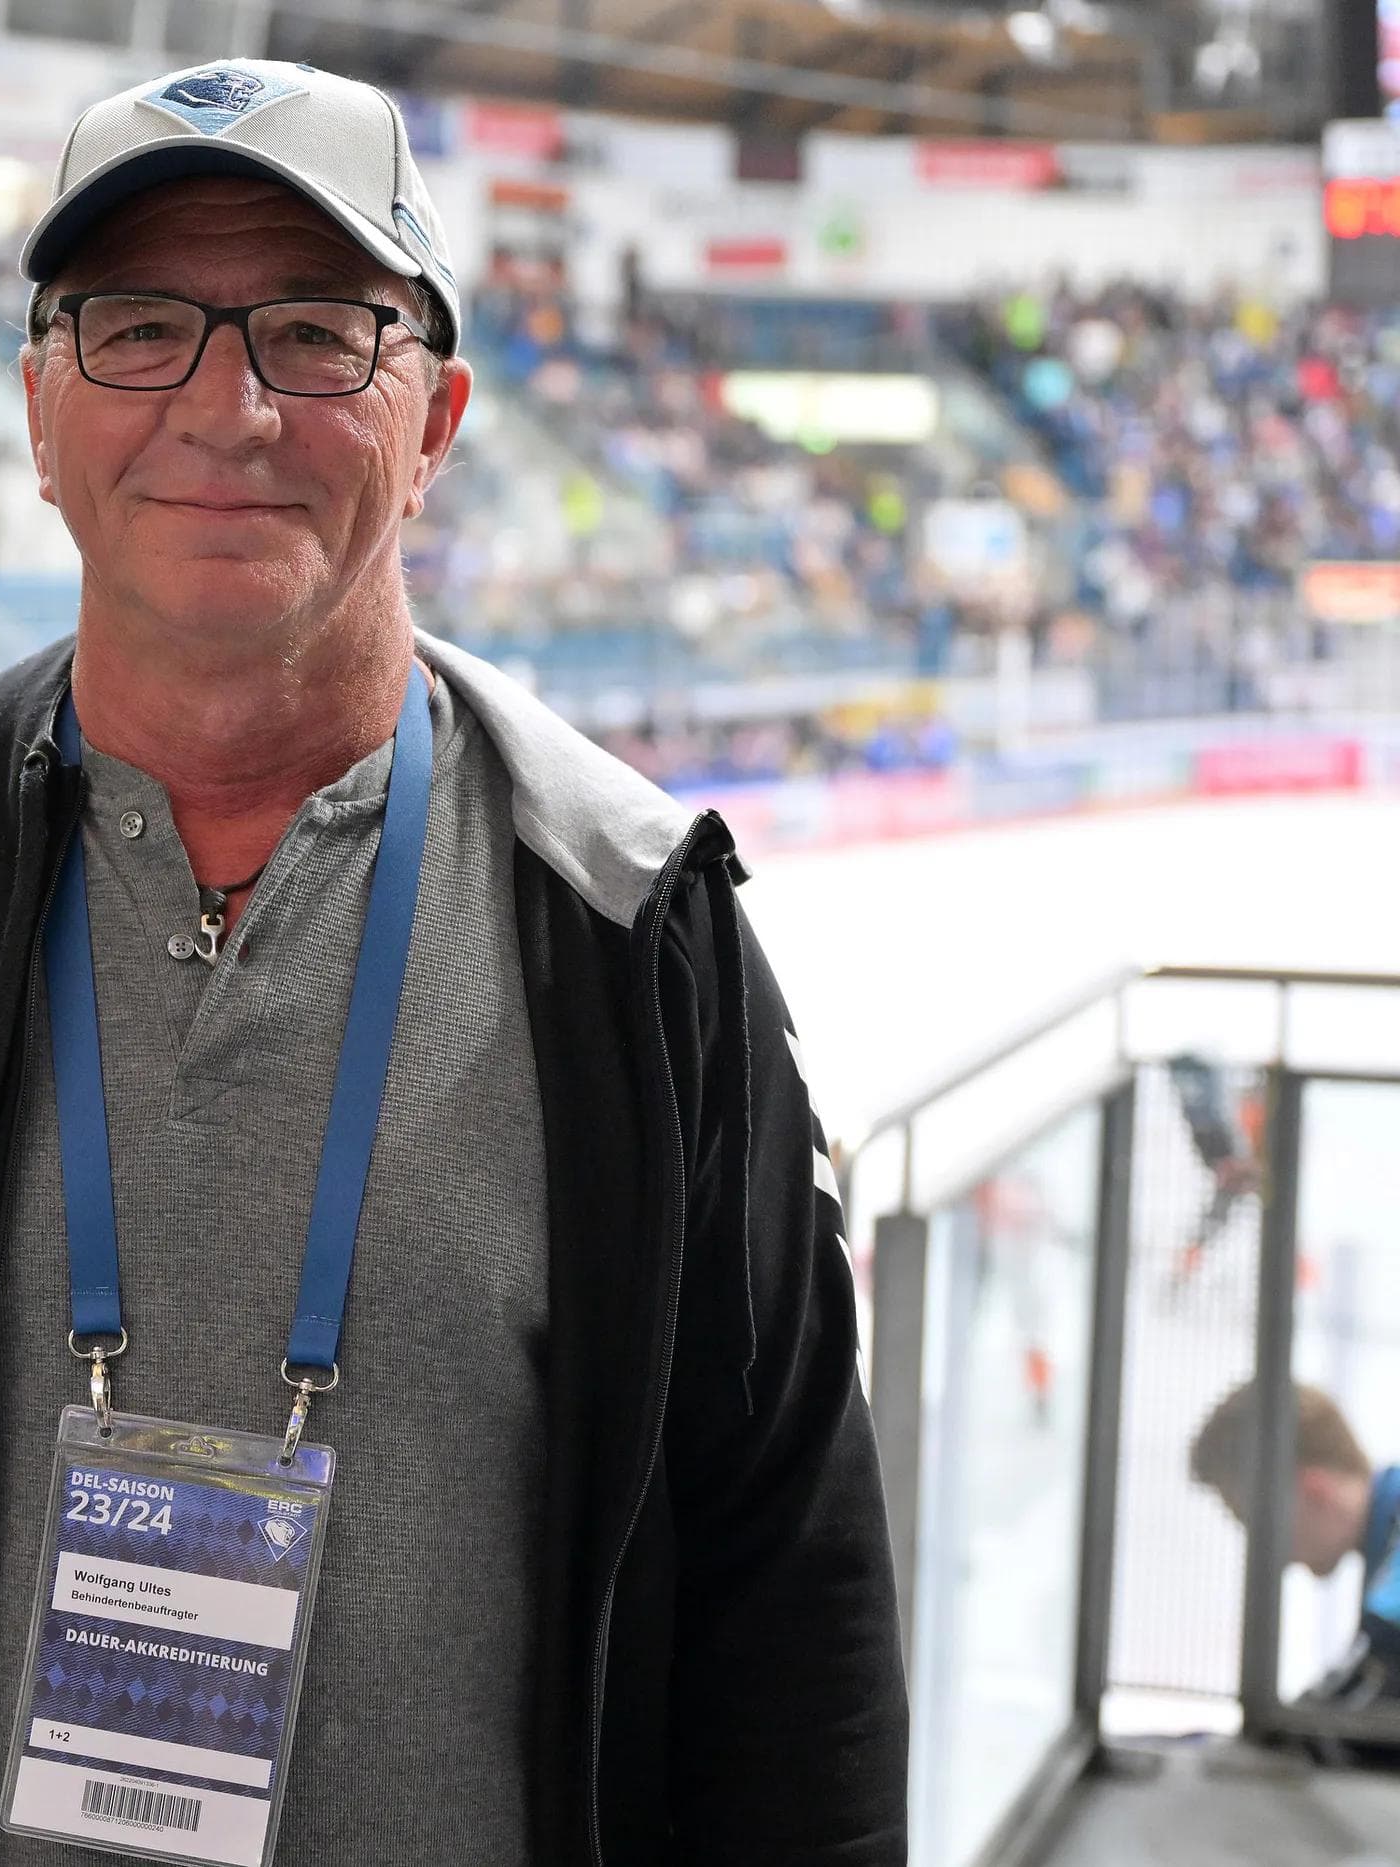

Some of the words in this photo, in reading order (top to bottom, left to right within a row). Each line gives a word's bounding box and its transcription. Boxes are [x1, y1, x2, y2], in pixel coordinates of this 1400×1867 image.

[72, 1471, 174, 1501] DEL-SAISON
[66, 1490, 172, 1535] 23/24
[268, 1499, 303, 1513] ERC
[74, 1569, 135, 1593] Wolfgang
[139, 1580, 172, 1597] Ultes
[71, 1590, 199, 1621] Behindertenbeauftragter
[65, 1628, 269, 1677] DAUER-AKKREDITIERUNG
[49, 1729, 70, 1742] 1+2
